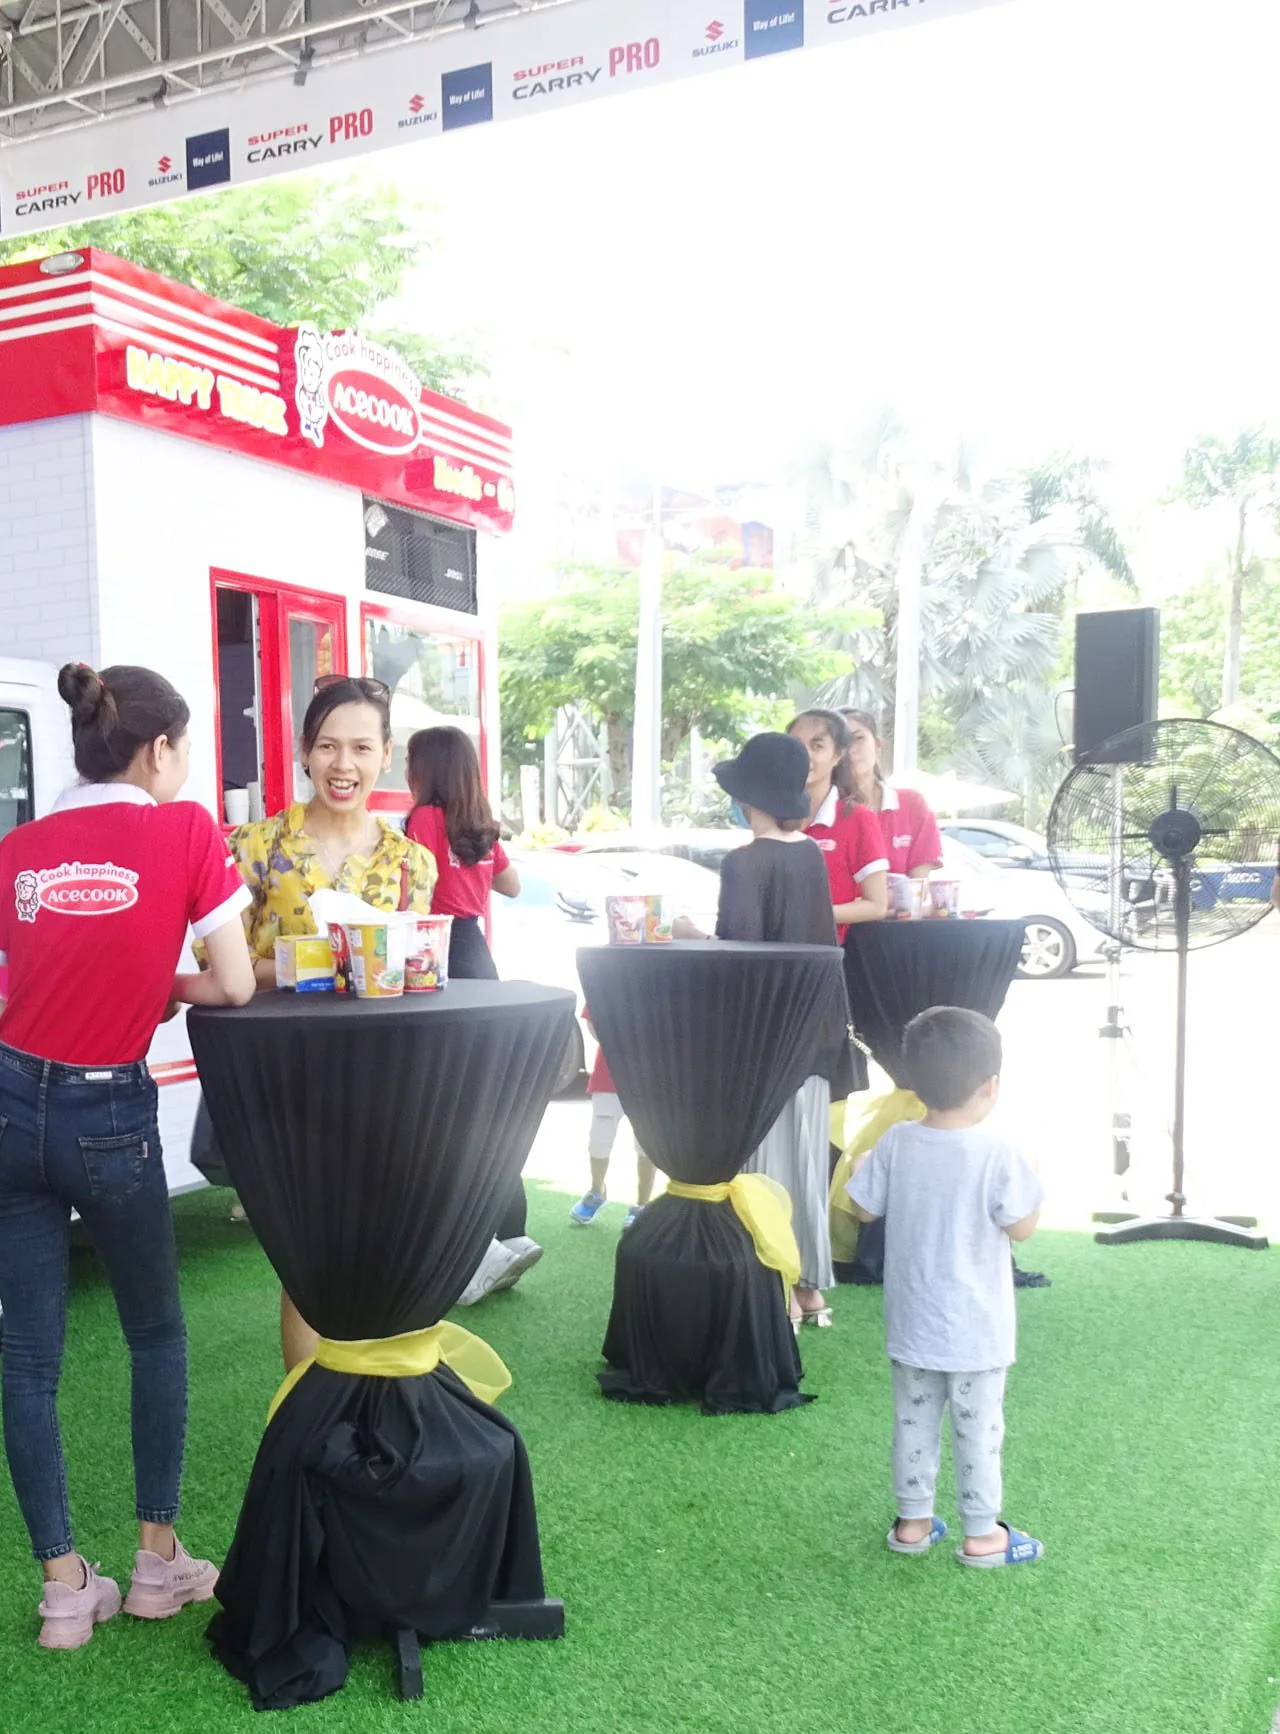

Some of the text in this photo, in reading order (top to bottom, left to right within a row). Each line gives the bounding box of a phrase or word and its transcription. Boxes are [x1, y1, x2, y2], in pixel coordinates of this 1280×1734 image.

[609, 37, 660, 77] PRO
[692, 39, 739, 58] SUZUKI
[513, 56, 584, 81] SUPER
[512, 67, 602, 100] CARRY
[330, 108, 374, 144] PRO
[398, 112, 437, 128] SUZUKI
[248, 124, 308, 146] SUPER
[246, 134, 324, 164] CARRY
[16, 180, 69, 200] SUPER
[87, 168, 125, 200] PRO
[148, 173, 183, 187] SUZUKI
[15, 191, 82, 216] CARRY
[40, 864, 136, 883] Cook happiness
